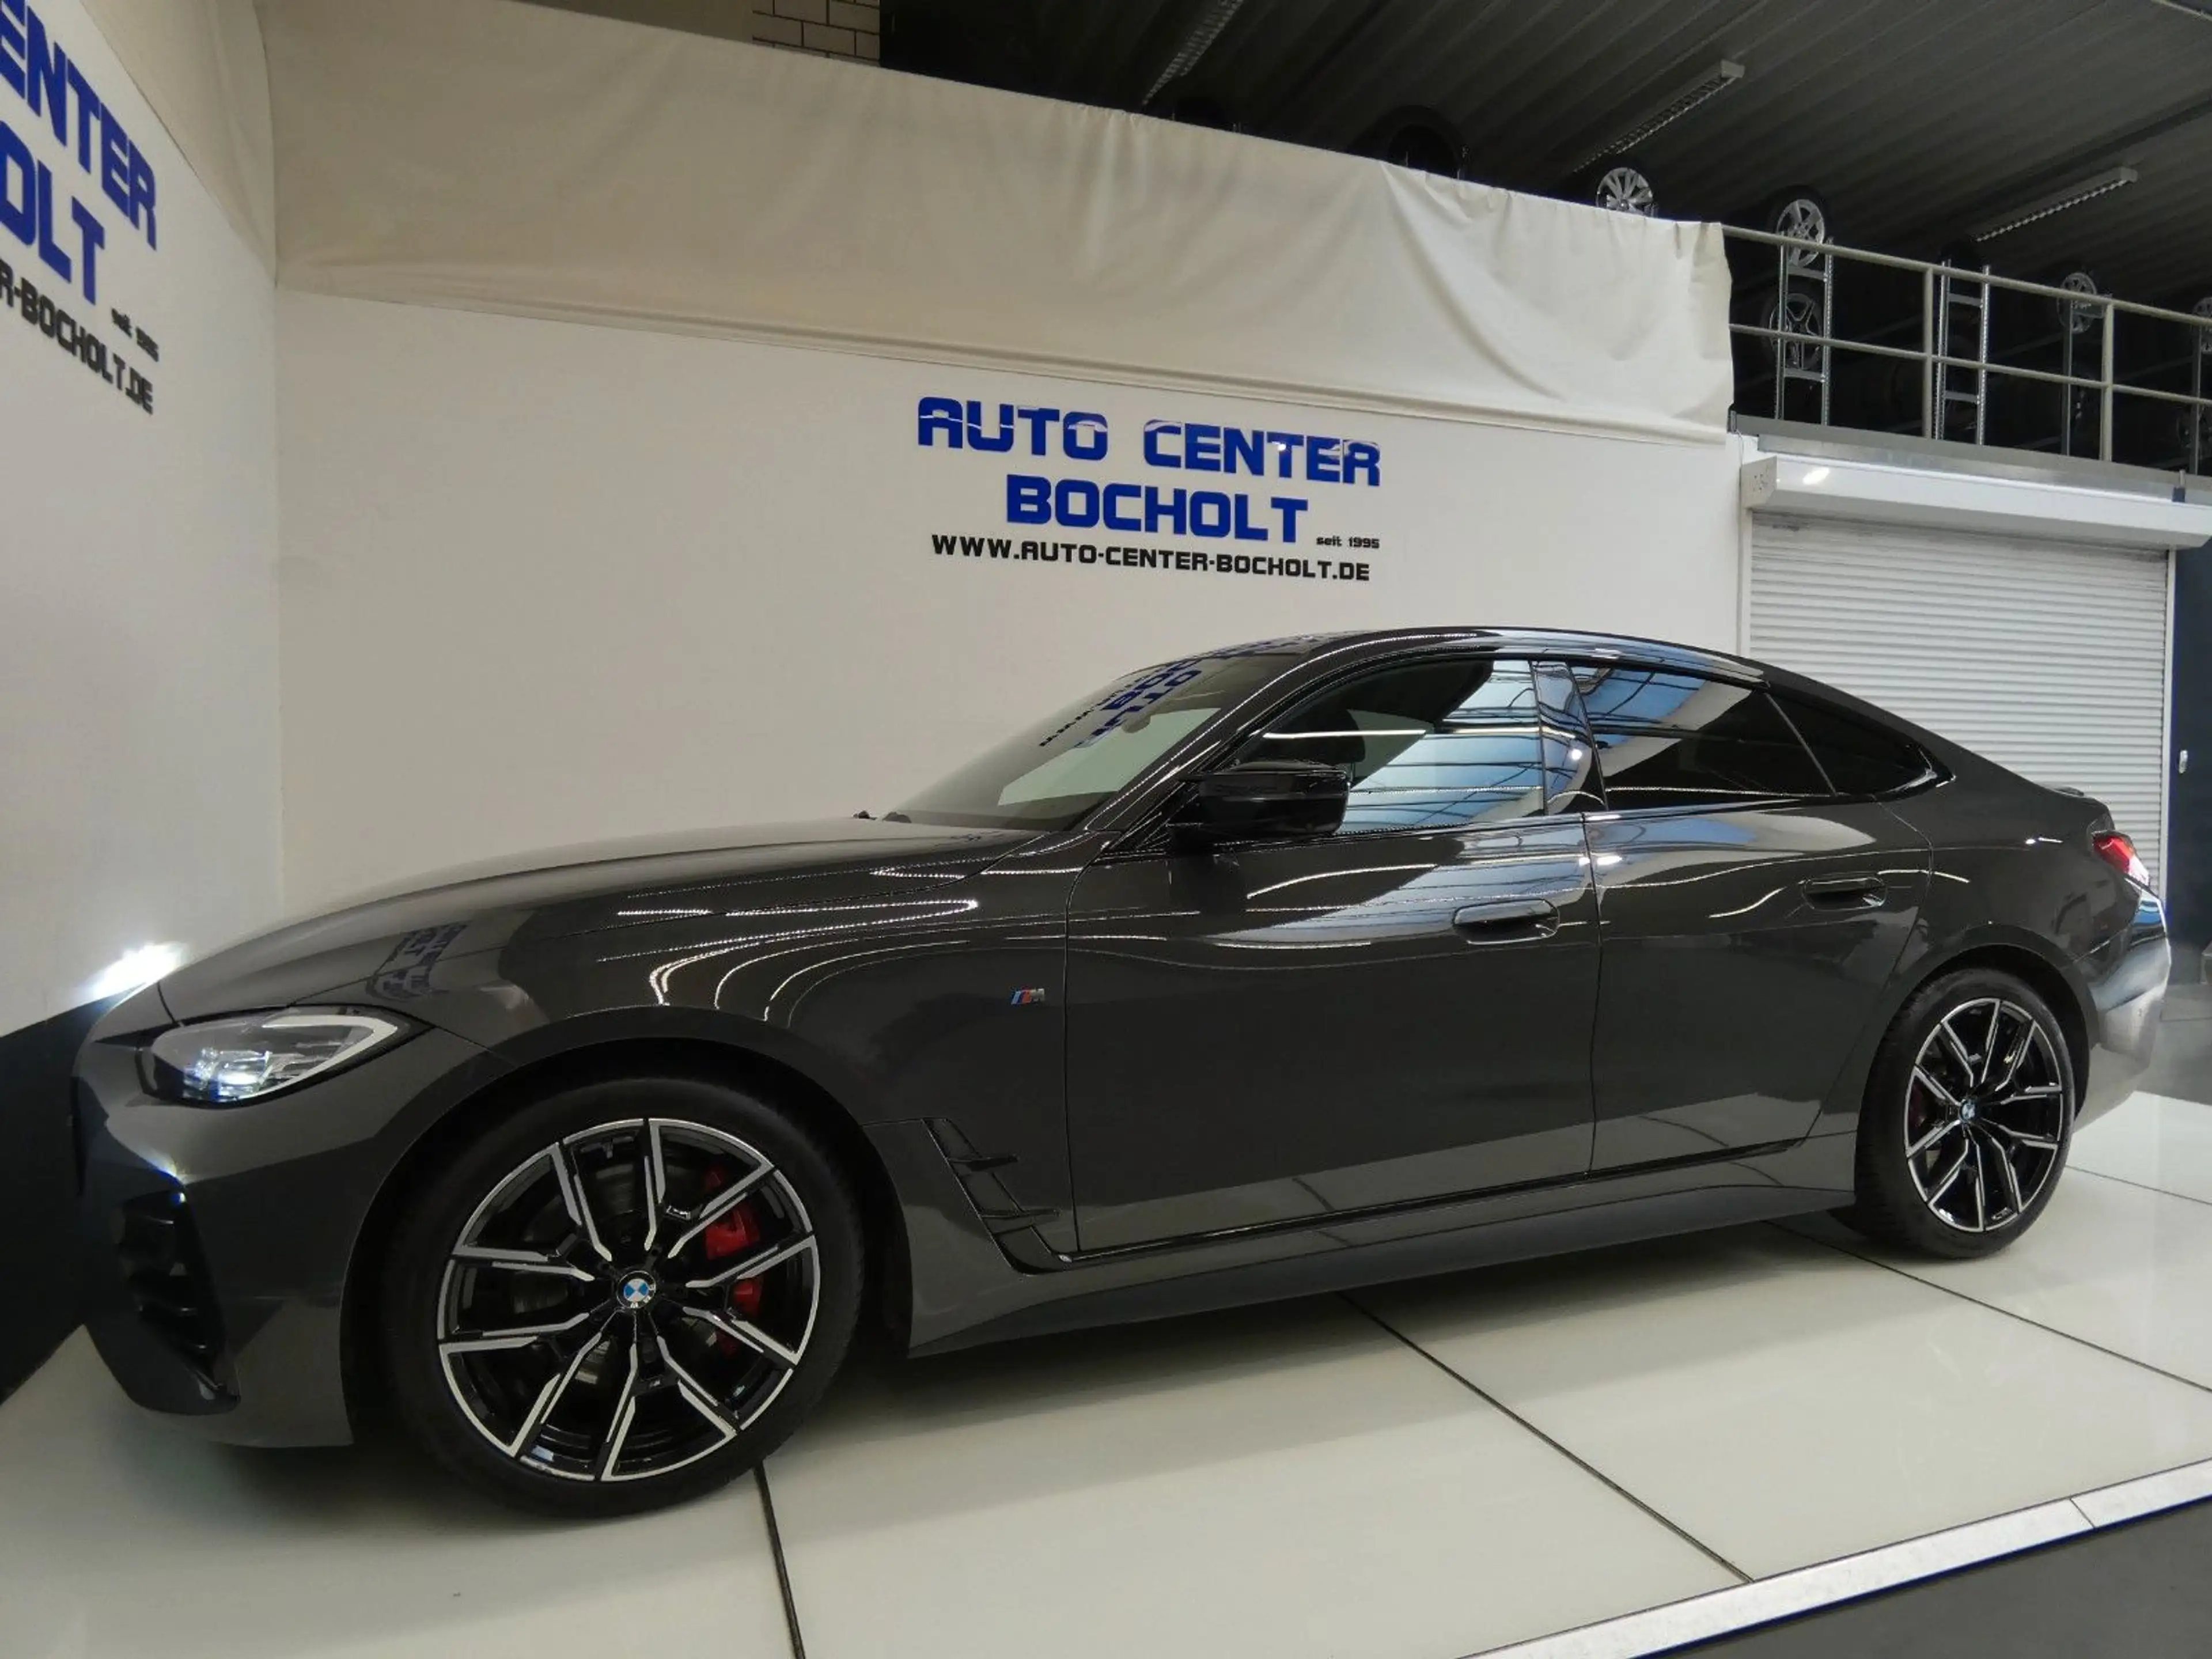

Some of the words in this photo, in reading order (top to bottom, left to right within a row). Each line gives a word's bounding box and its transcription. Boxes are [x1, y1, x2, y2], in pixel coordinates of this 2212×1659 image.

[918, 396, 1108, 461] AUTO
[1144, 419, 1380, 487] CENTER
[1006, 474, 1308, 543] BOCHOLT
[931, 534, 1370, 582] WWW.AUTO-CENTER-BOCHOLT.DE
[1316, 535, 1342, 547] seit
[1349, 536, 1380, 549] 1995
